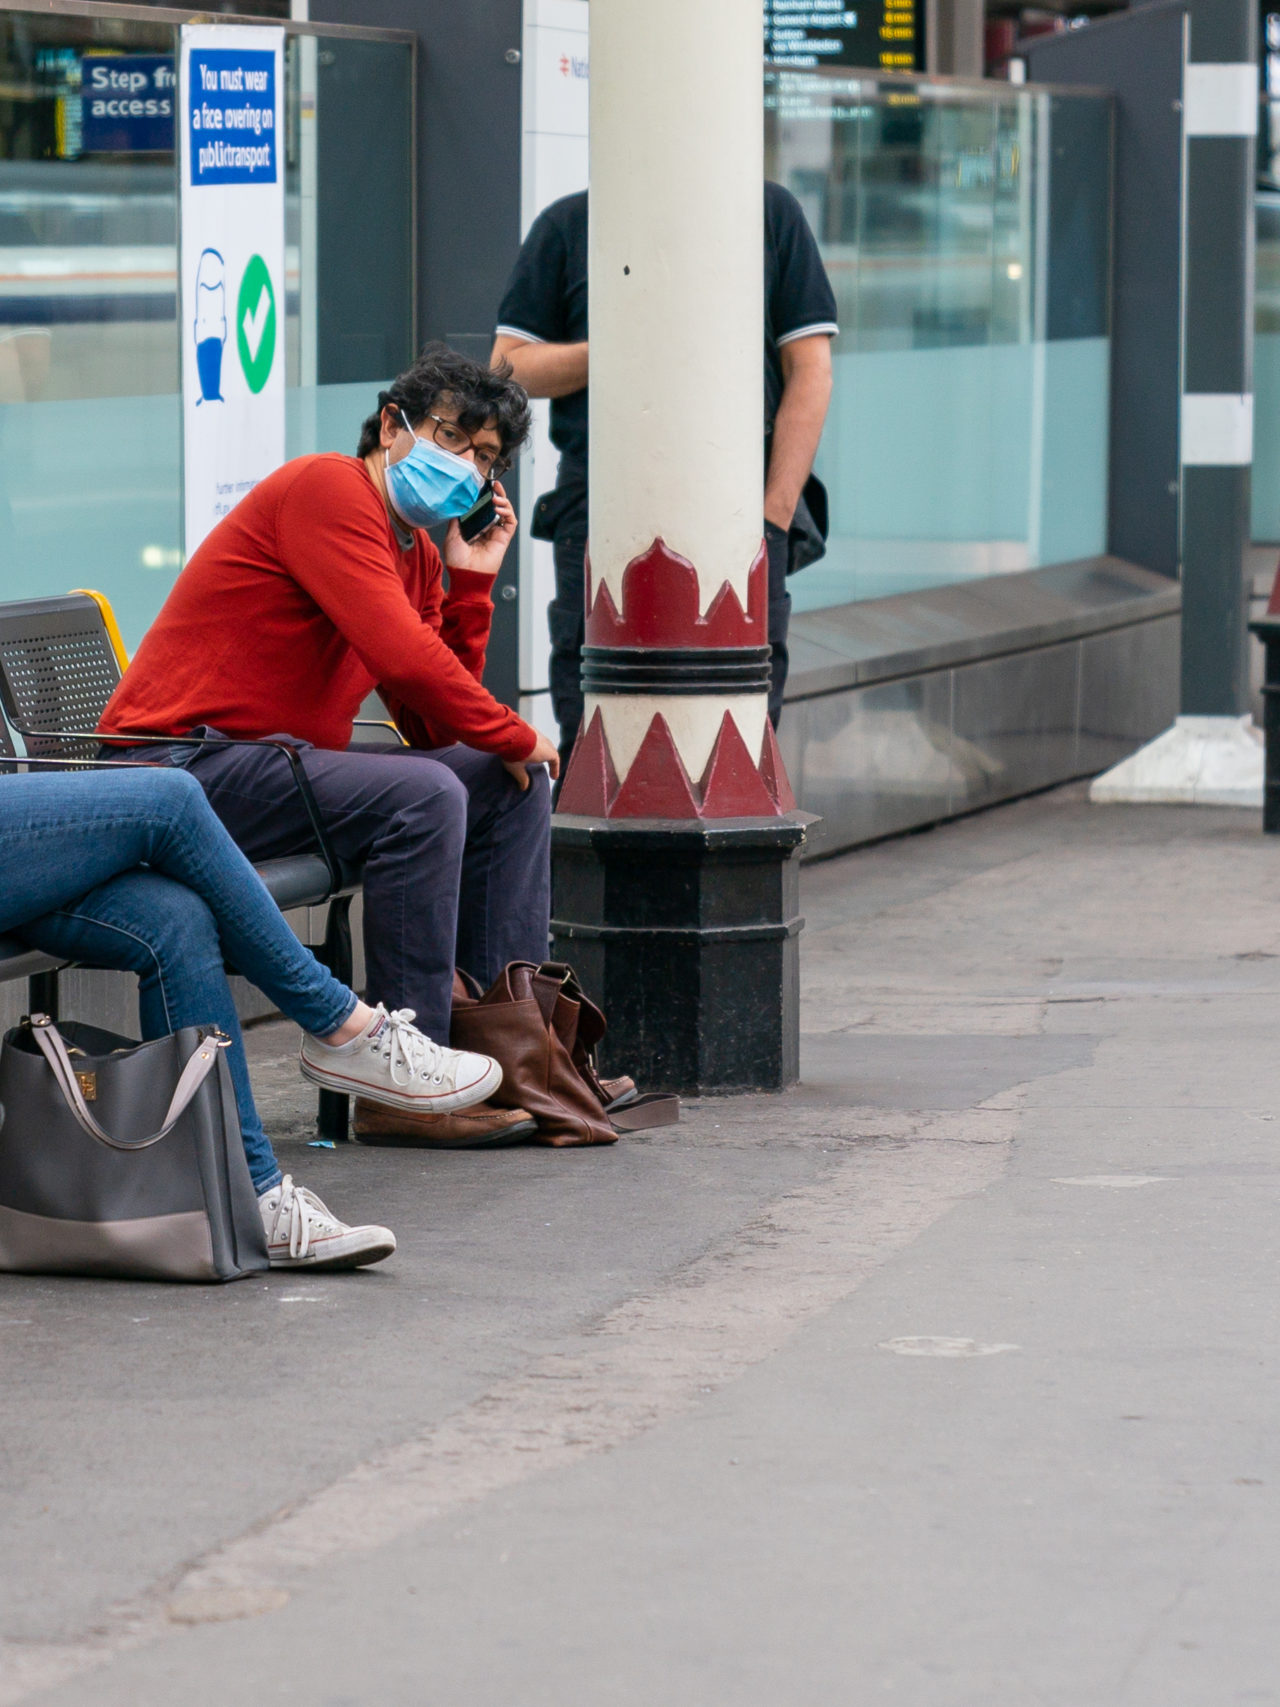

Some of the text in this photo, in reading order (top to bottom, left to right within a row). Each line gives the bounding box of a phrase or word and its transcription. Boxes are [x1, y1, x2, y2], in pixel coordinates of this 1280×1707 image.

[92, 66, 147, 92] Step
[199, 64, 268, 91] You must wear
[92, 99, 171, 116] access
[193, 102, 273, 135] a face covering on
